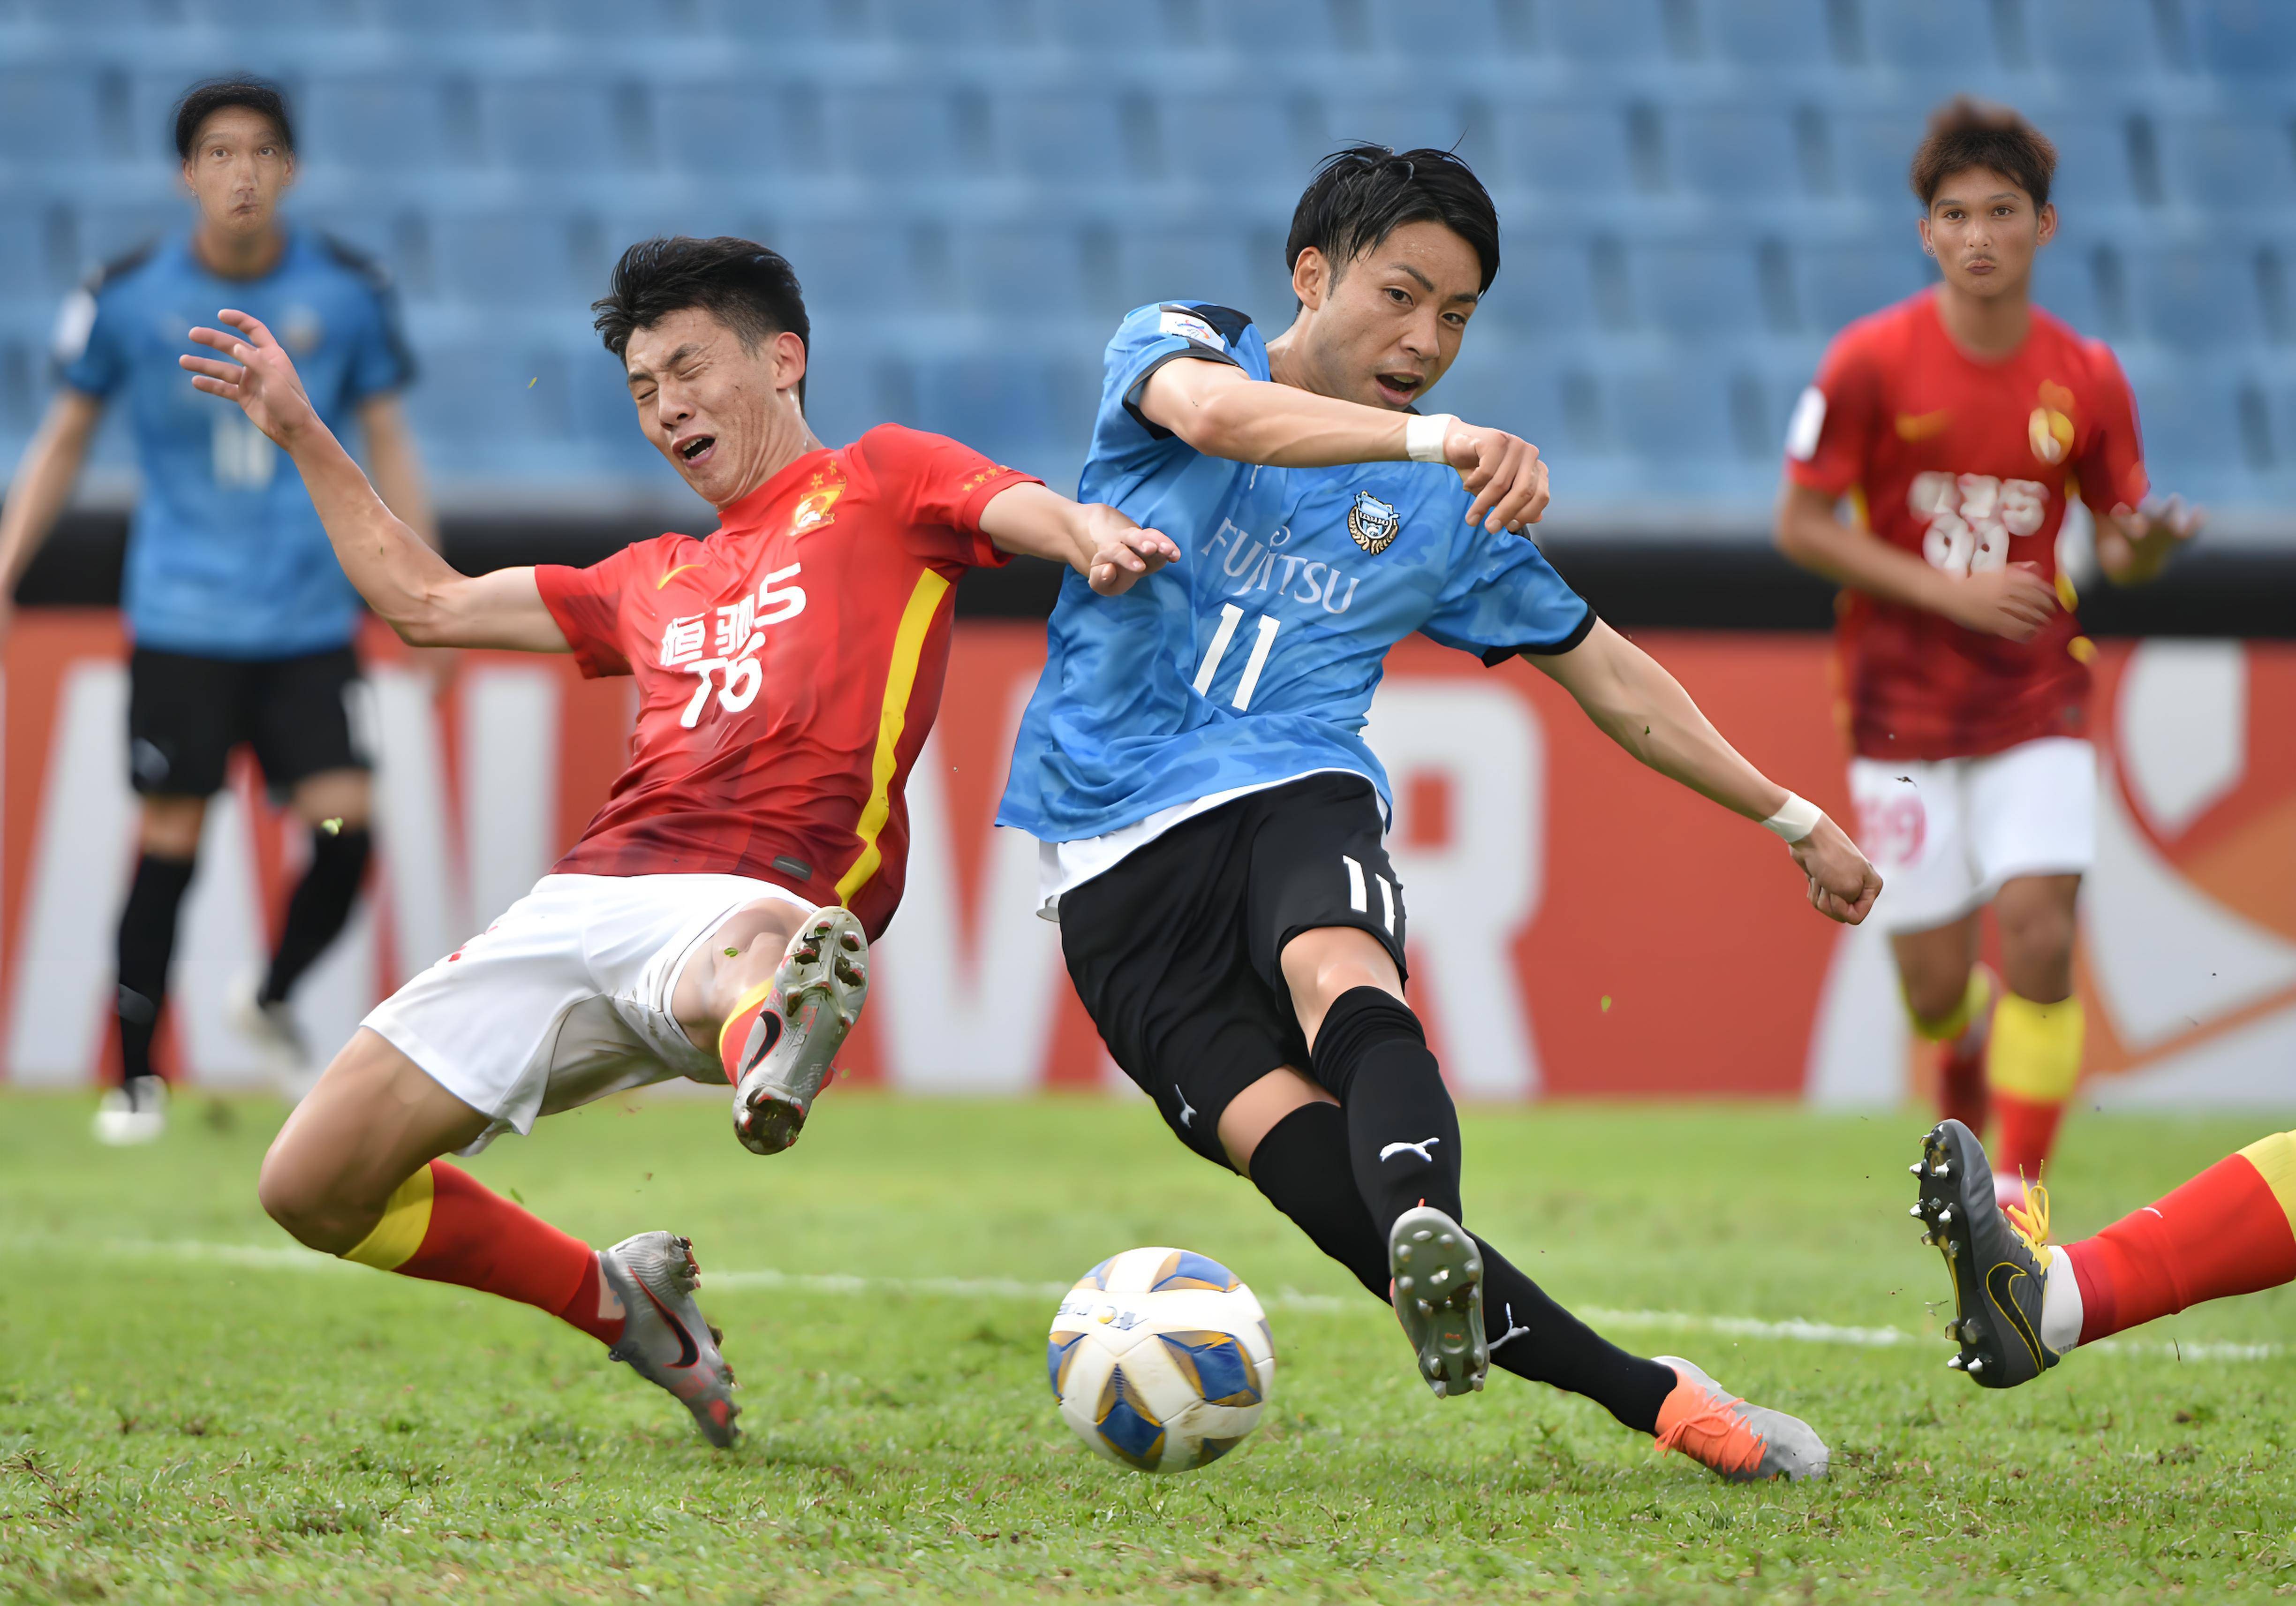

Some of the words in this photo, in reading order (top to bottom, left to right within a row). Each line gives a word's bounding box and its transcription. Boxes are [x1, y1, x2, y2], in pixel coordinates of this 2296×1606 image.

[1201, 517, 1360, 614] FUJITSU
[1192, 603, 1281, 712] 11
[1343, 855, 1396, 937] 11
